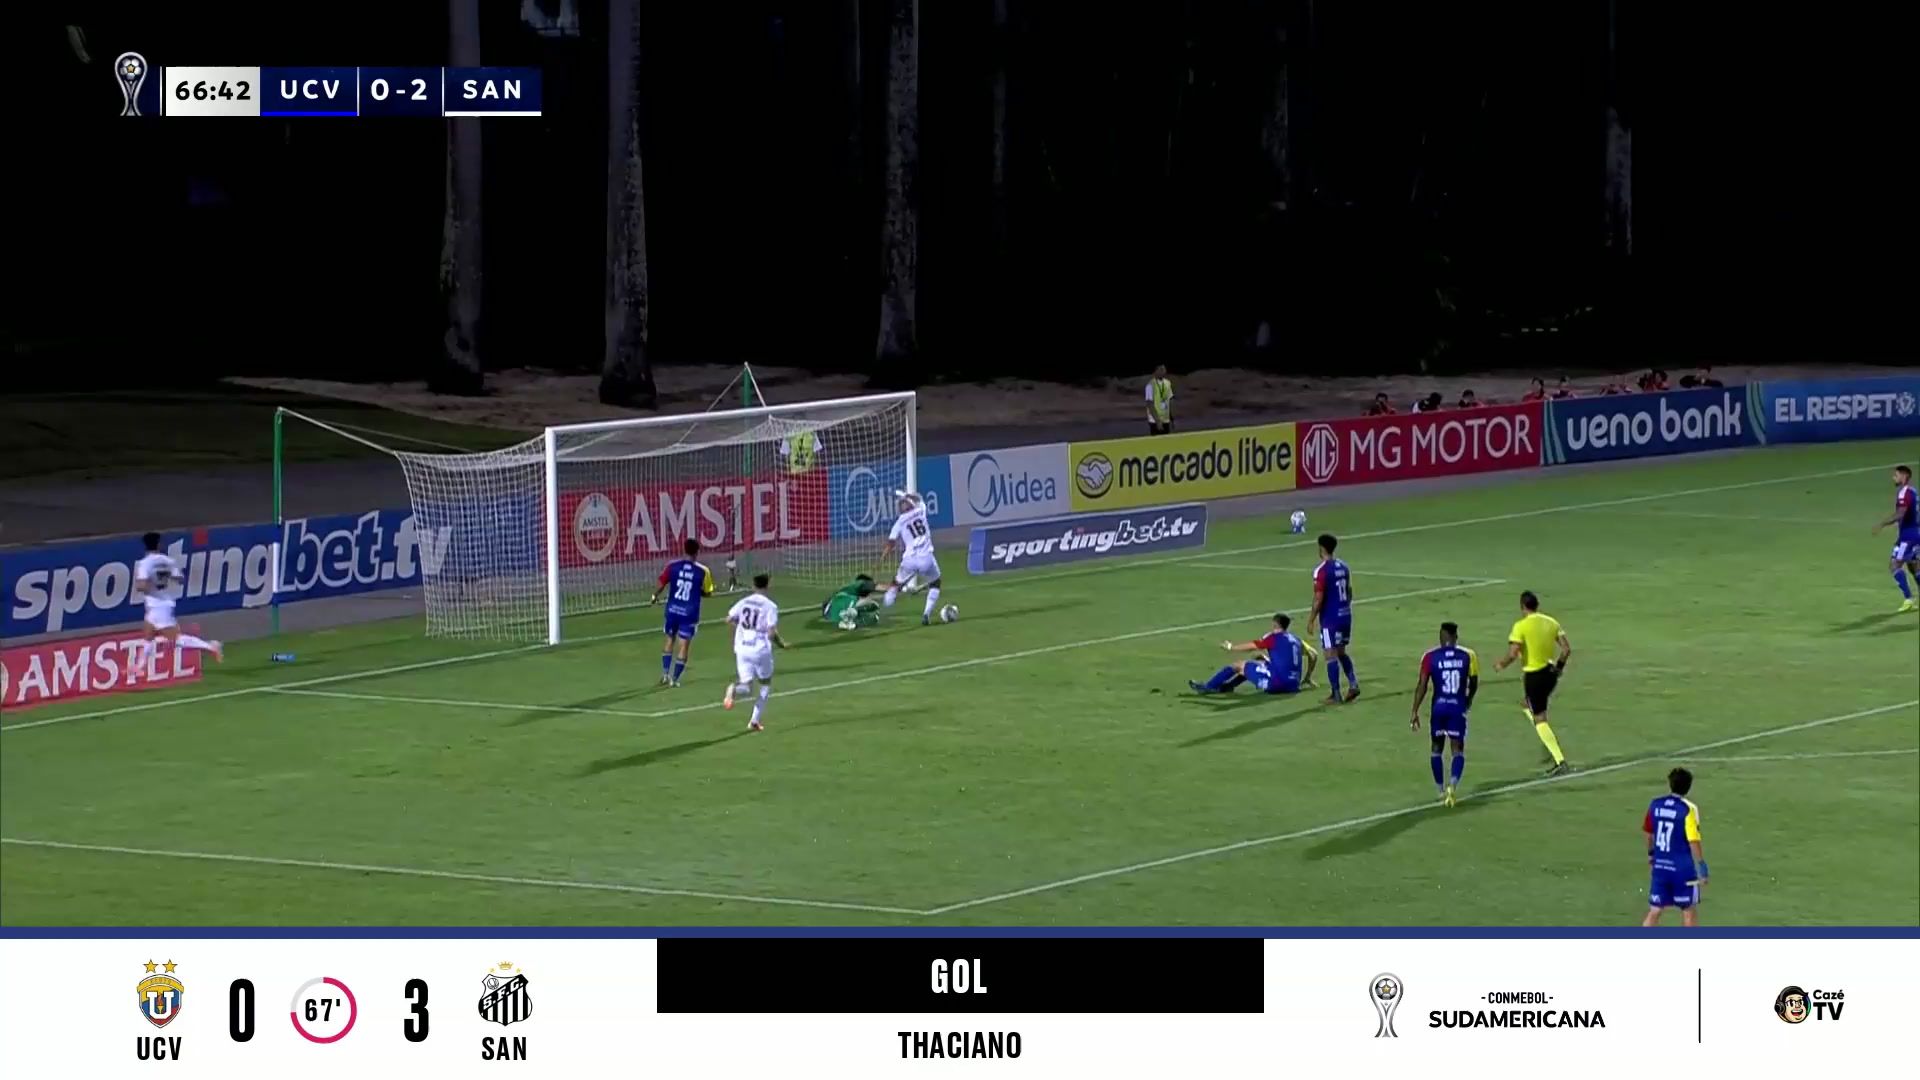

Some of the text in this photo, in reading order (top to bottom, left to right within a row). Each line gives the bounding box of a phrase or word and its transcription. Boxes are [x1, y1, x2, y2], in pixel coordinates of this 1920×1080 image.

[1567, 392, 1742, 450] ueno bank
[1775, 397, 1804, 423] EL
[1350, 414, 1534, 472] MG MOTOR
[1119, 438, 1292, 489] mercado libre
[982, 471, 1057, 509] Midea
[625, 481, 801, 554] AMSTEL
[906, 518, 926, 539] 16
[991, 516, 1198, 564] sportingbet.tv
[674, 579, 693, 602] 28
[742, 607, 760, 630] 31
[1442, 669, 1461, 695] 30
[1656, 821, 1675, 853] 47
